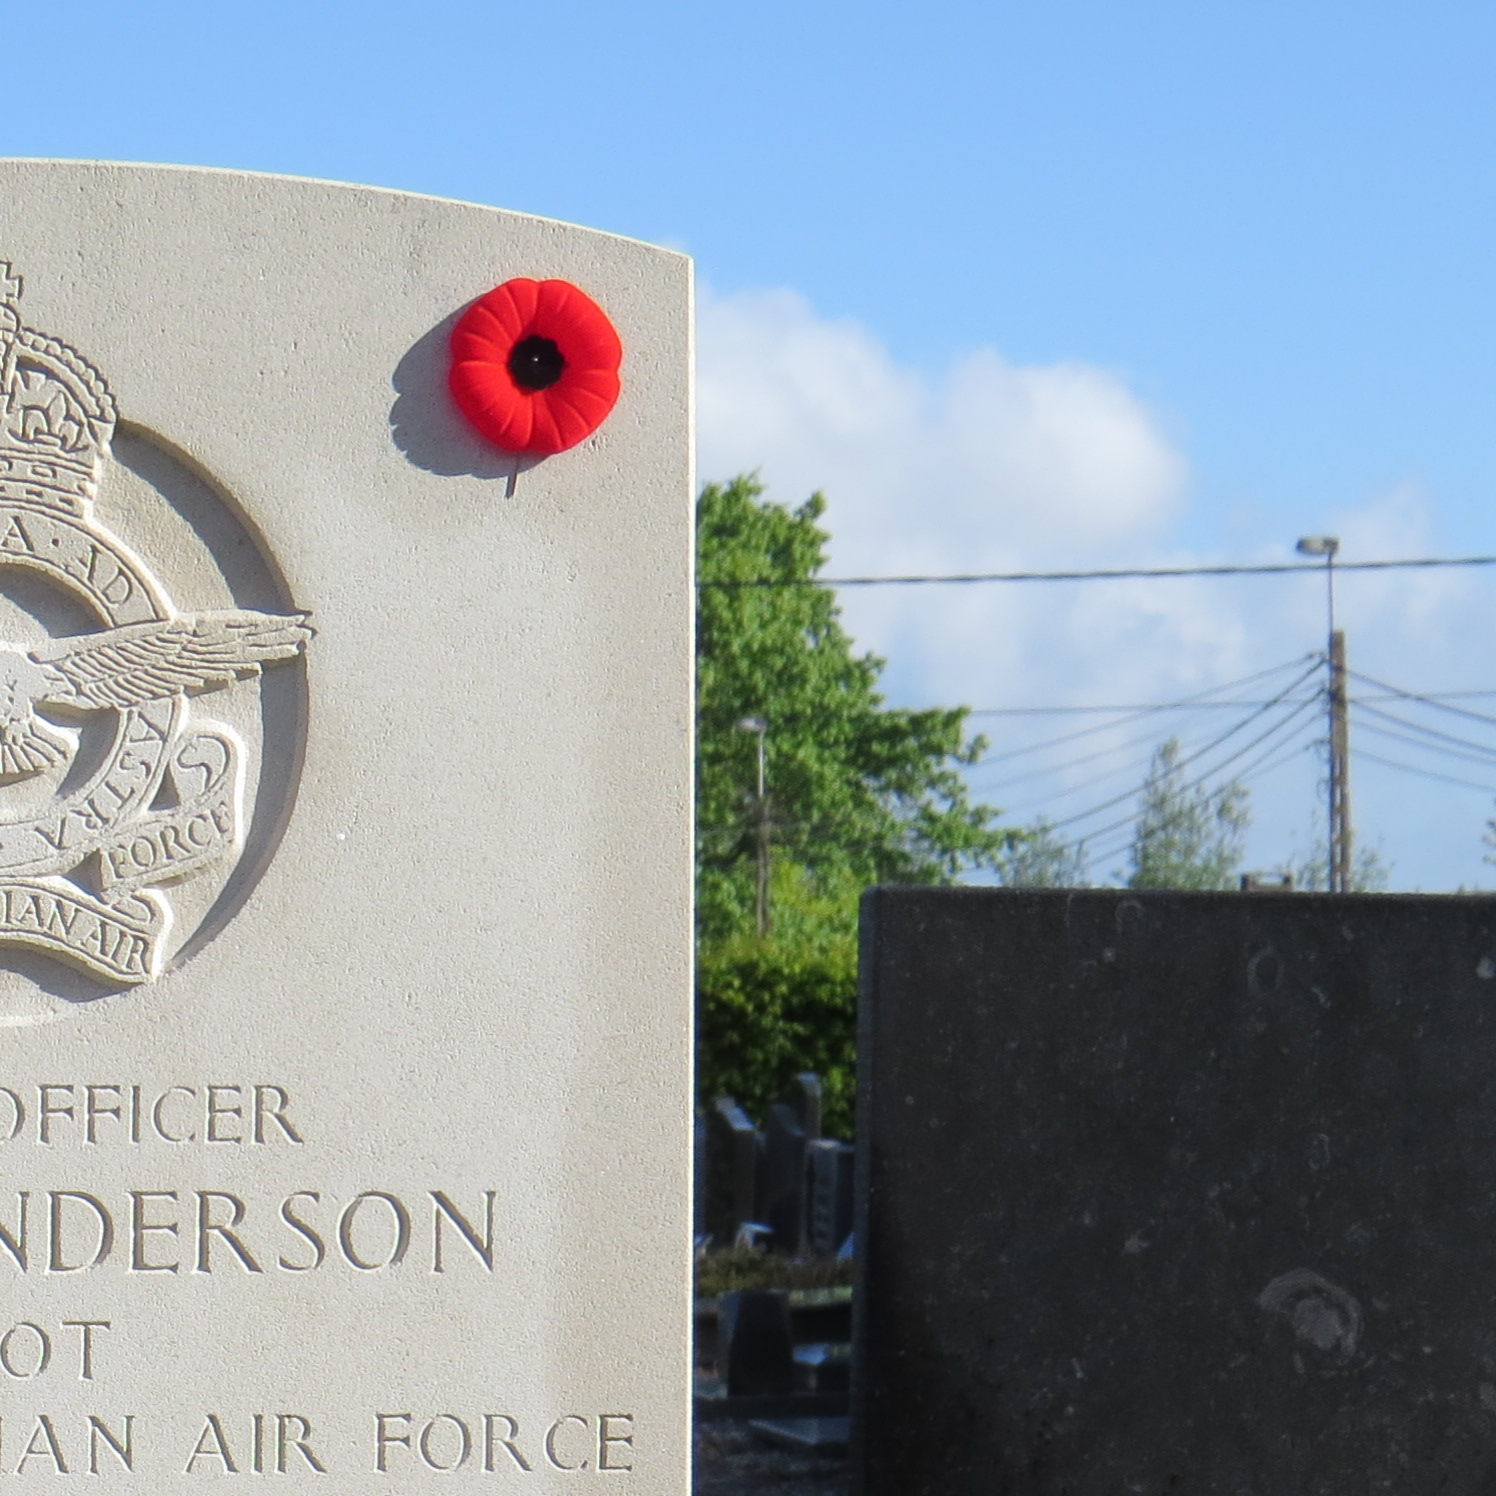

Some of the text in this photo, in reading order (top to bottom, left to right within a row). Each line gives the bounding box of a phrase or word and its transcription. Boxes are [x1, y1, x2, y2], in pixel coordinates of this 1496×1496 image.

[77, 543, 134, 607] AD
[35, 708, 169, 851] ASTRA
[106, 800, 232, 879] FORCE
[79, 919, 151, 975] AIR
[184, 1413, 328, 1475] AIR
[372, 1412, 634, 1474] FORCE
